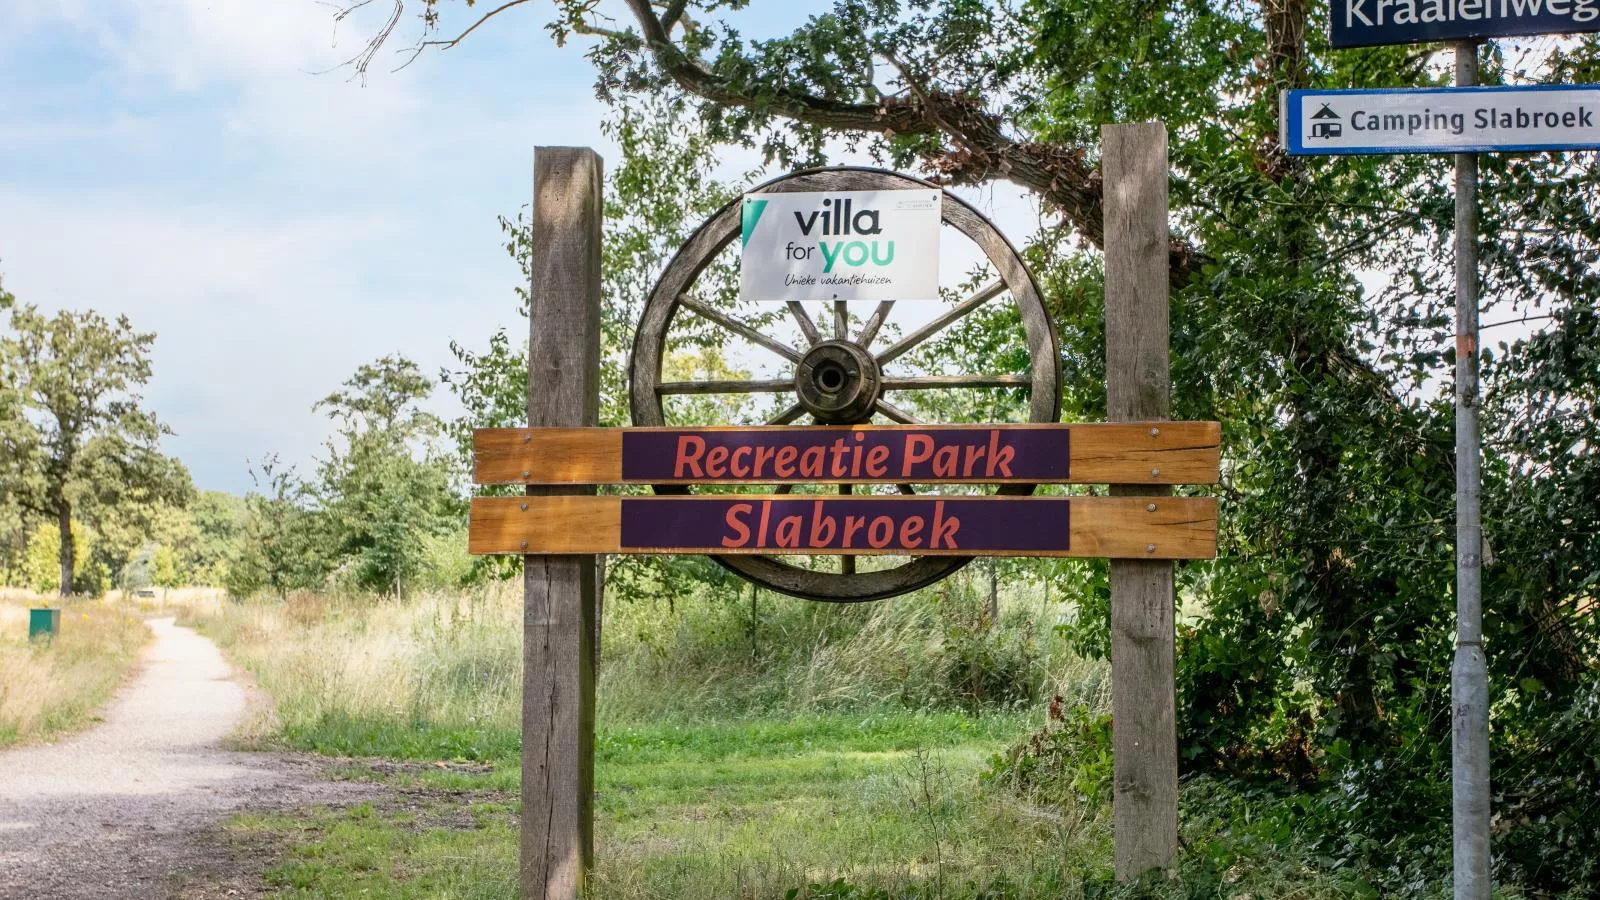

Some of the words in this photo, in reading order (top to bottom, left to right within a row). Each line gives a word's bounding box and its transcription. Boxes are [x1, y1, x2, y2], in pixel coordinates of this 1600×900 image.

[1351, 109, 1464, 134] Camping
[1474, 106, 1593, 130] Slabroek
[793, 198, 883, 236] villa
[785, 241, 816, 260] for
[818, 240, 895, 273] you
[784, 273, 817, 287] Unieke
[820, 273, 892, 286] vakantiehuizen
[673, 431, 889, 479] Recreatie
[902, 430, 1016, 478] Park
[722, 500, 961, 550] Slabroek
